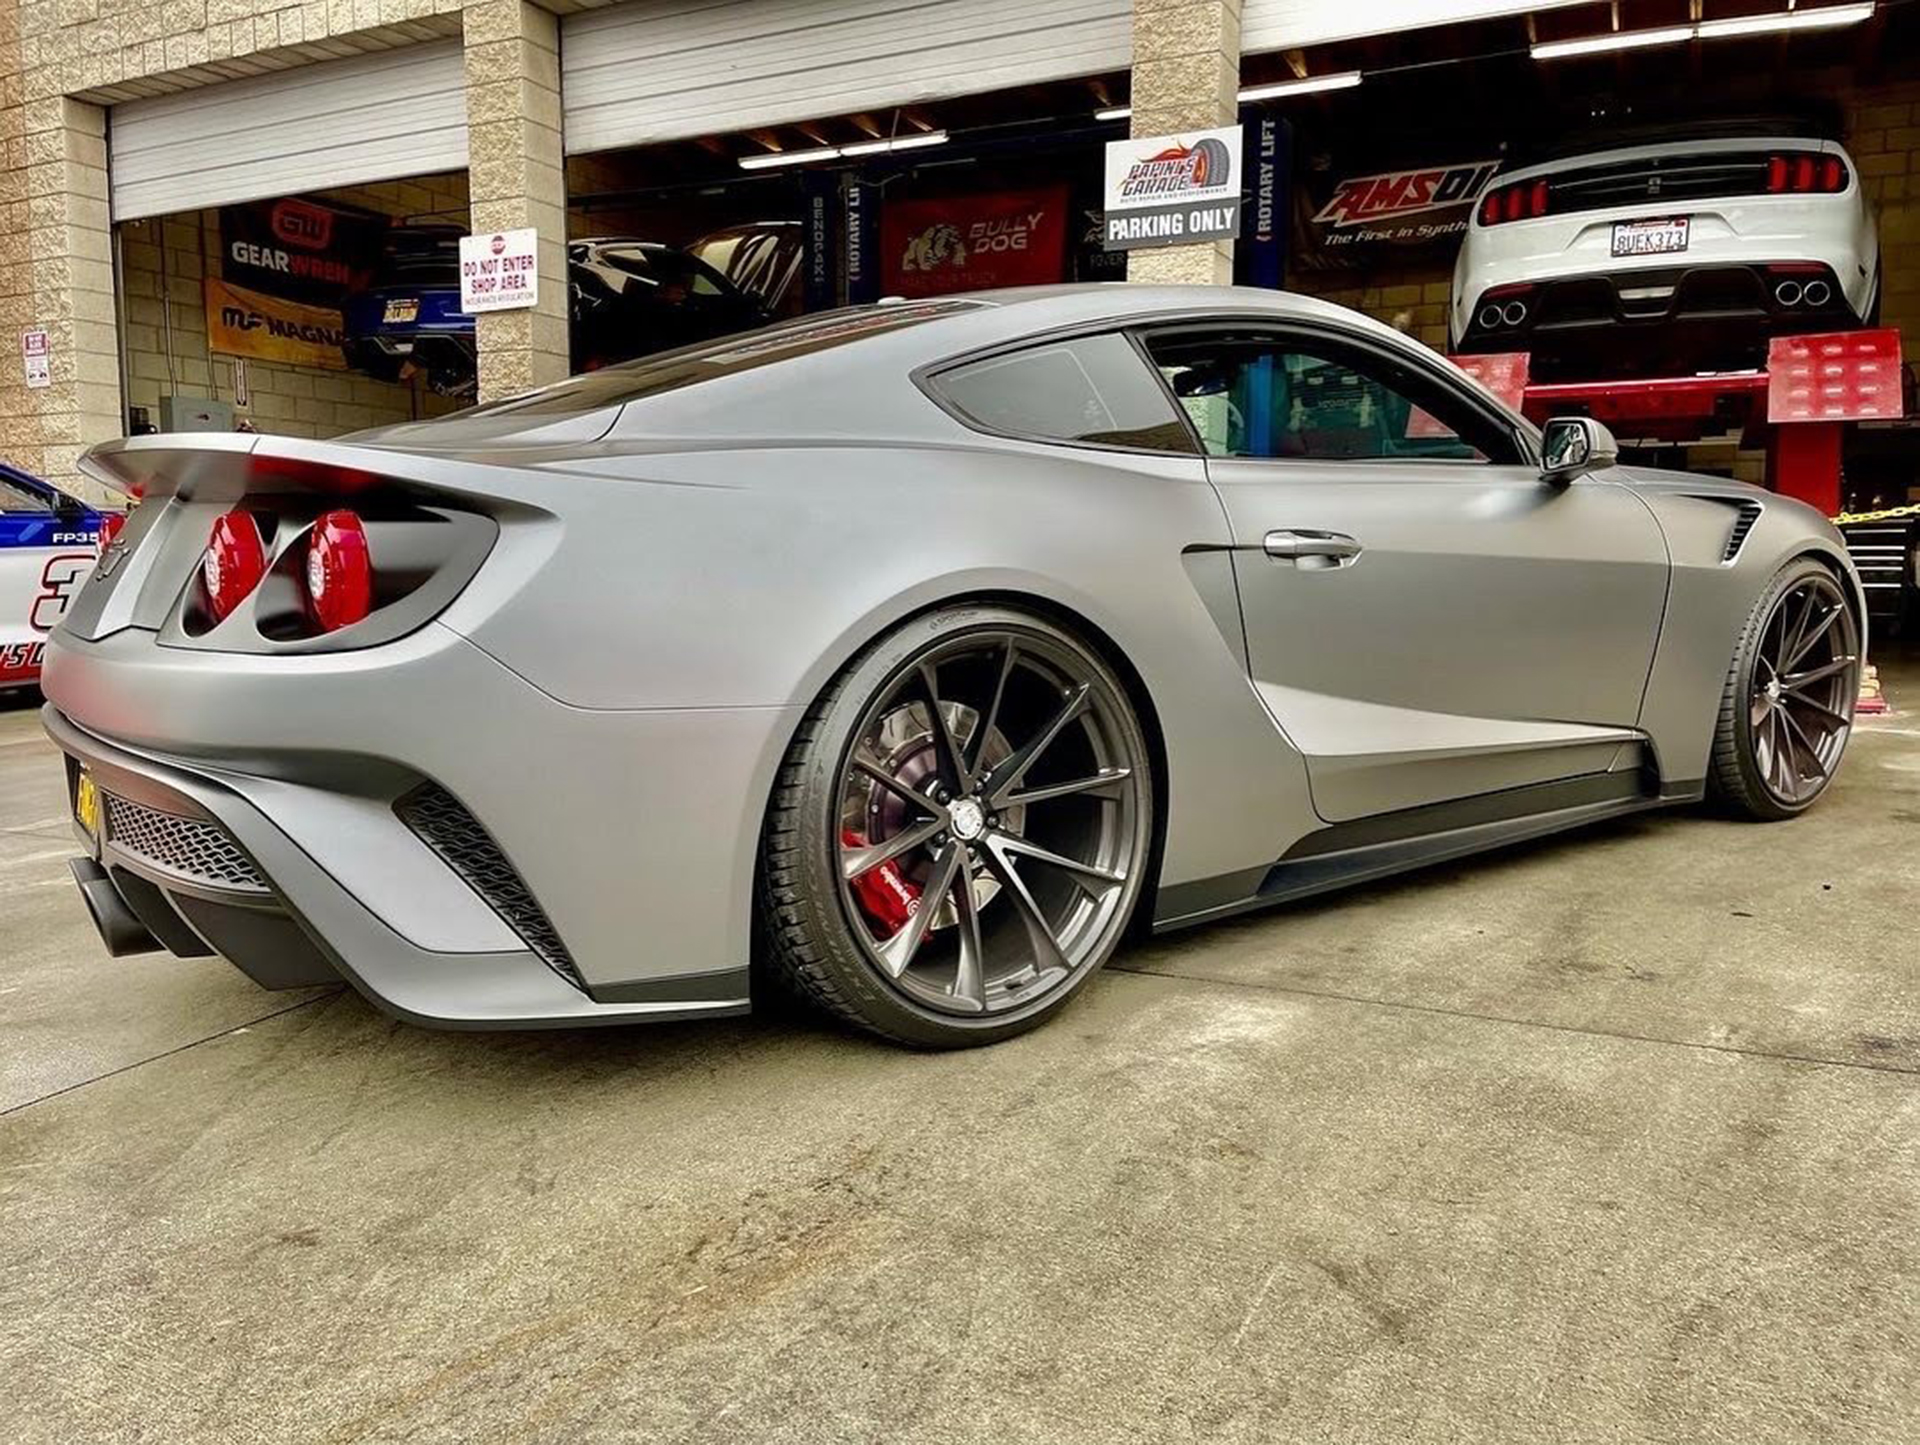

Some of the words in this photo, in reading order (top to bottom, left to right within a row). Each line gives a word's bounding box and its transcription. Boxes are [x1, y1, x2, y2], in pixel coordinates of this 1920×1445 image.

[1261, 120, 1276, 157] LIFT
[1122, 174, 1190, 197] GARAGE
[1258, 162, 1274, 233] ROTARY
[1311, 160, 1503, 227] AMSOI
[969, 212, 1044, 239] BULLY
[1109, 212, 1184, 240] PARKING
[1189, 206, 1235, 233] ONLY
[1324, 232, 1353, 246] The
[1355, 229, 1392, 243] First
[1417, 219, 1471, 238] Synth
[849, 212, 860, 273] ROTARY
[974, 232, 1028, 254] DOG
[464, 262, 477, 277] DO
[480, 258, 499, 275] NOT
[503, 254, 534, 272] ENTER
[471, 277, 497, 294] SHOP
[501, 273, 527, 290] AREA
[52, 532, 100, 543] FP35
